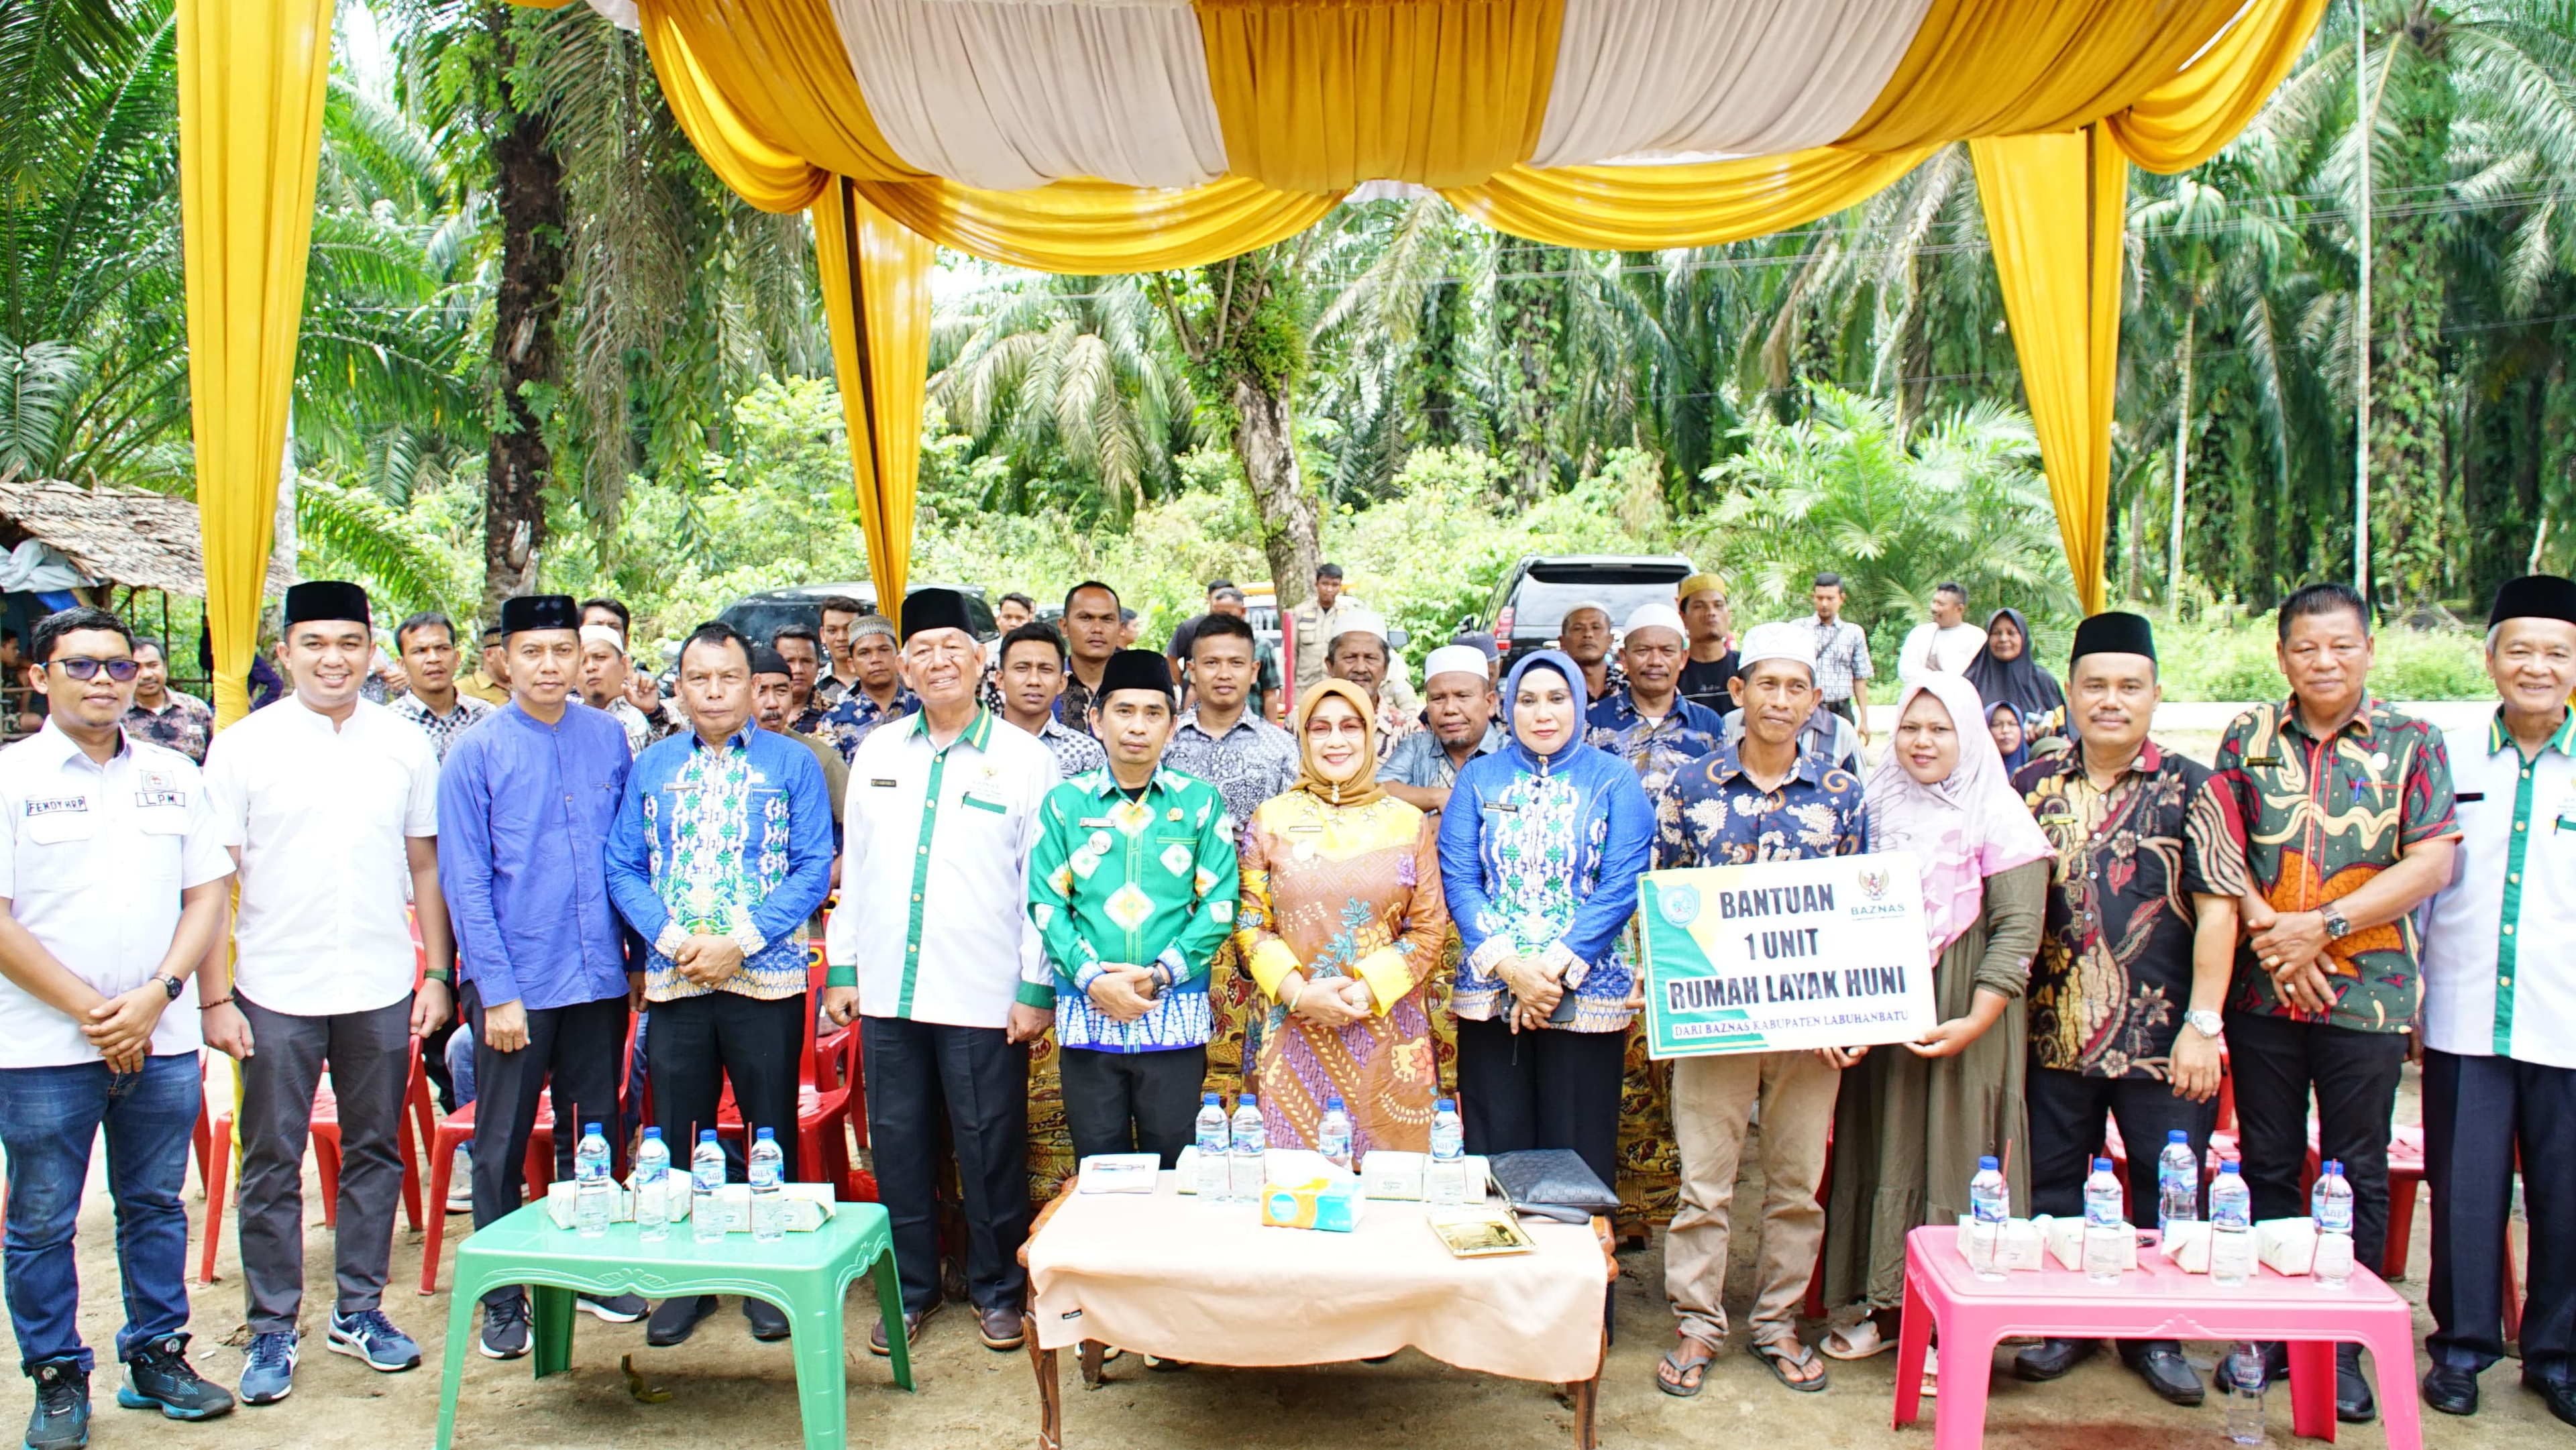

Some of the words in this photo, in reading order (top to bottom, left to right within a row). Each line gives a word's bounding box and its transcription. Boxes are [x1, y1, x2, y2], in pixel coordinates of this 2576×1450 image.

[1719, 883, 1835, 919] BANTUAN
[1851, 903, 1905, 915] BAZNAS
[1744, 933, 1756, 960] 1
[1762, 928, 1819, 959] UNIT
[1669, 976, 1759, 1009] RUMAH
[1766, 970, 1839, 1003] LAYAK
[1845, 966, 1906, 997] HUNI
[1675, 1025, 1702, 1036] DARI
[1706, 1022, 1750, 1034] BAZNAS
[1753, 1016, 1820, 1031] KABUPATEN
[1824, 1010, 1909, 1025] LABUHANBATU
